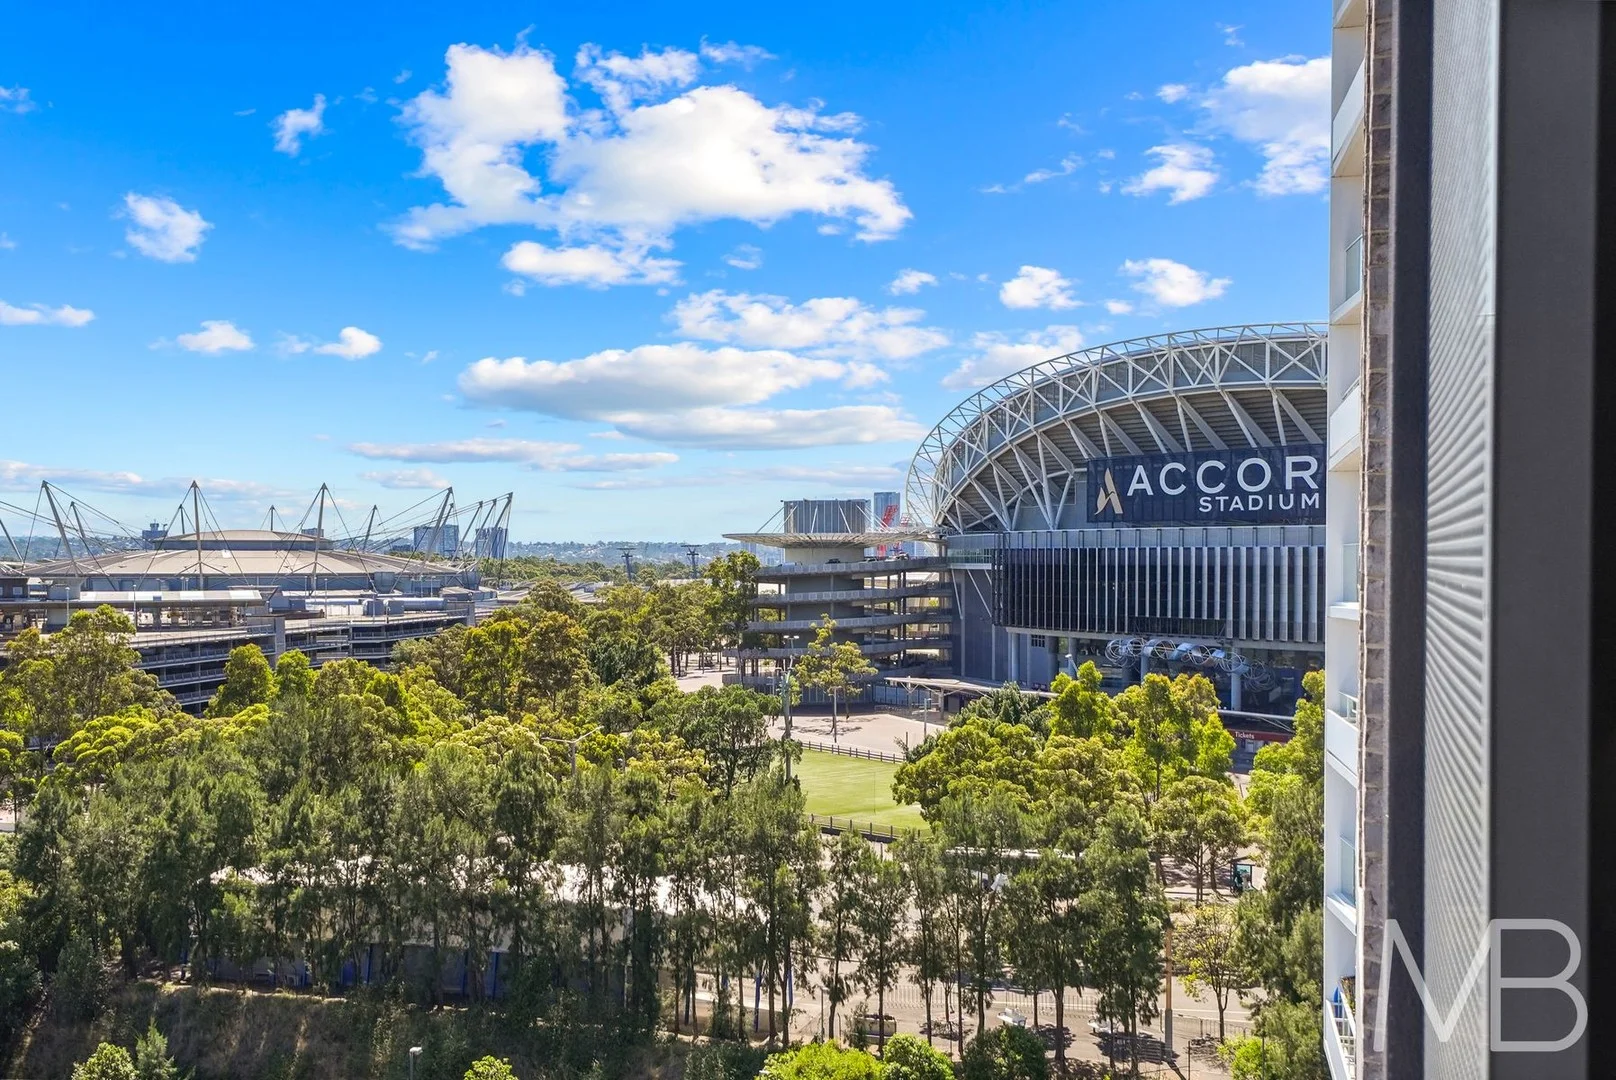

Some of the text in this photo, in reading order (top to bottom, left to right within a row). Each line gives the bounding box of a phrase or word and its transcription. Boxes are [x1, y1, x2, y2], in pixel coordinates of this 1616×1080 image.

[1127, 455, 1319, 496] ACCOR
[1198, 492, 1320, 512] STADIUM
[1235, 731, 1255, 740] Tickets
